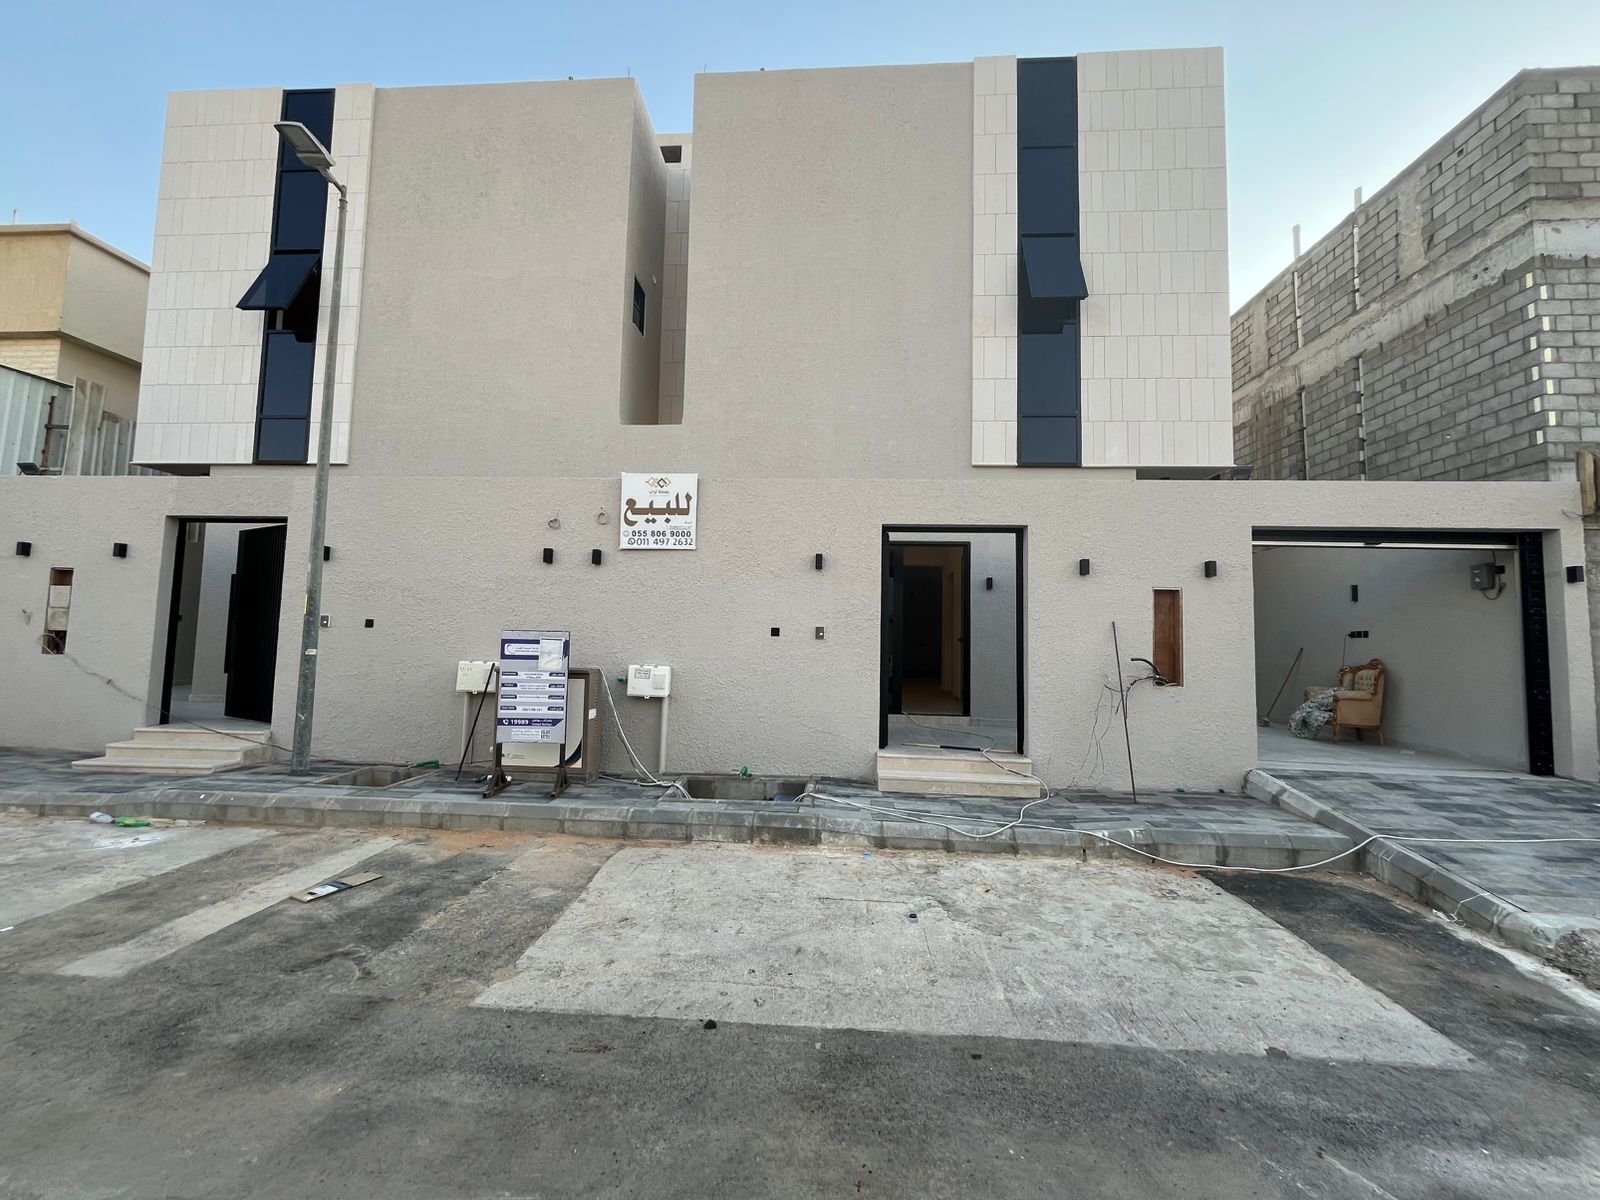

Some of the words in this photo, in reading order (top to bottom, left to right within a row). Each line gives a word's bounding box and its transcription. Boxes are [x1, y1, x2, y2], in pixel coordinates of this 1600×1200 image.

[624, 492, 692, 527] للبيع
[631, 530, 648, 538] 055
[650, 530, 667, 538] 806
[669, 530, 692, 538] 9000
[636, 537, 649, 546] 011
[653, 537, 670, 546] 497
[672, 537, 693, 546] 2632
